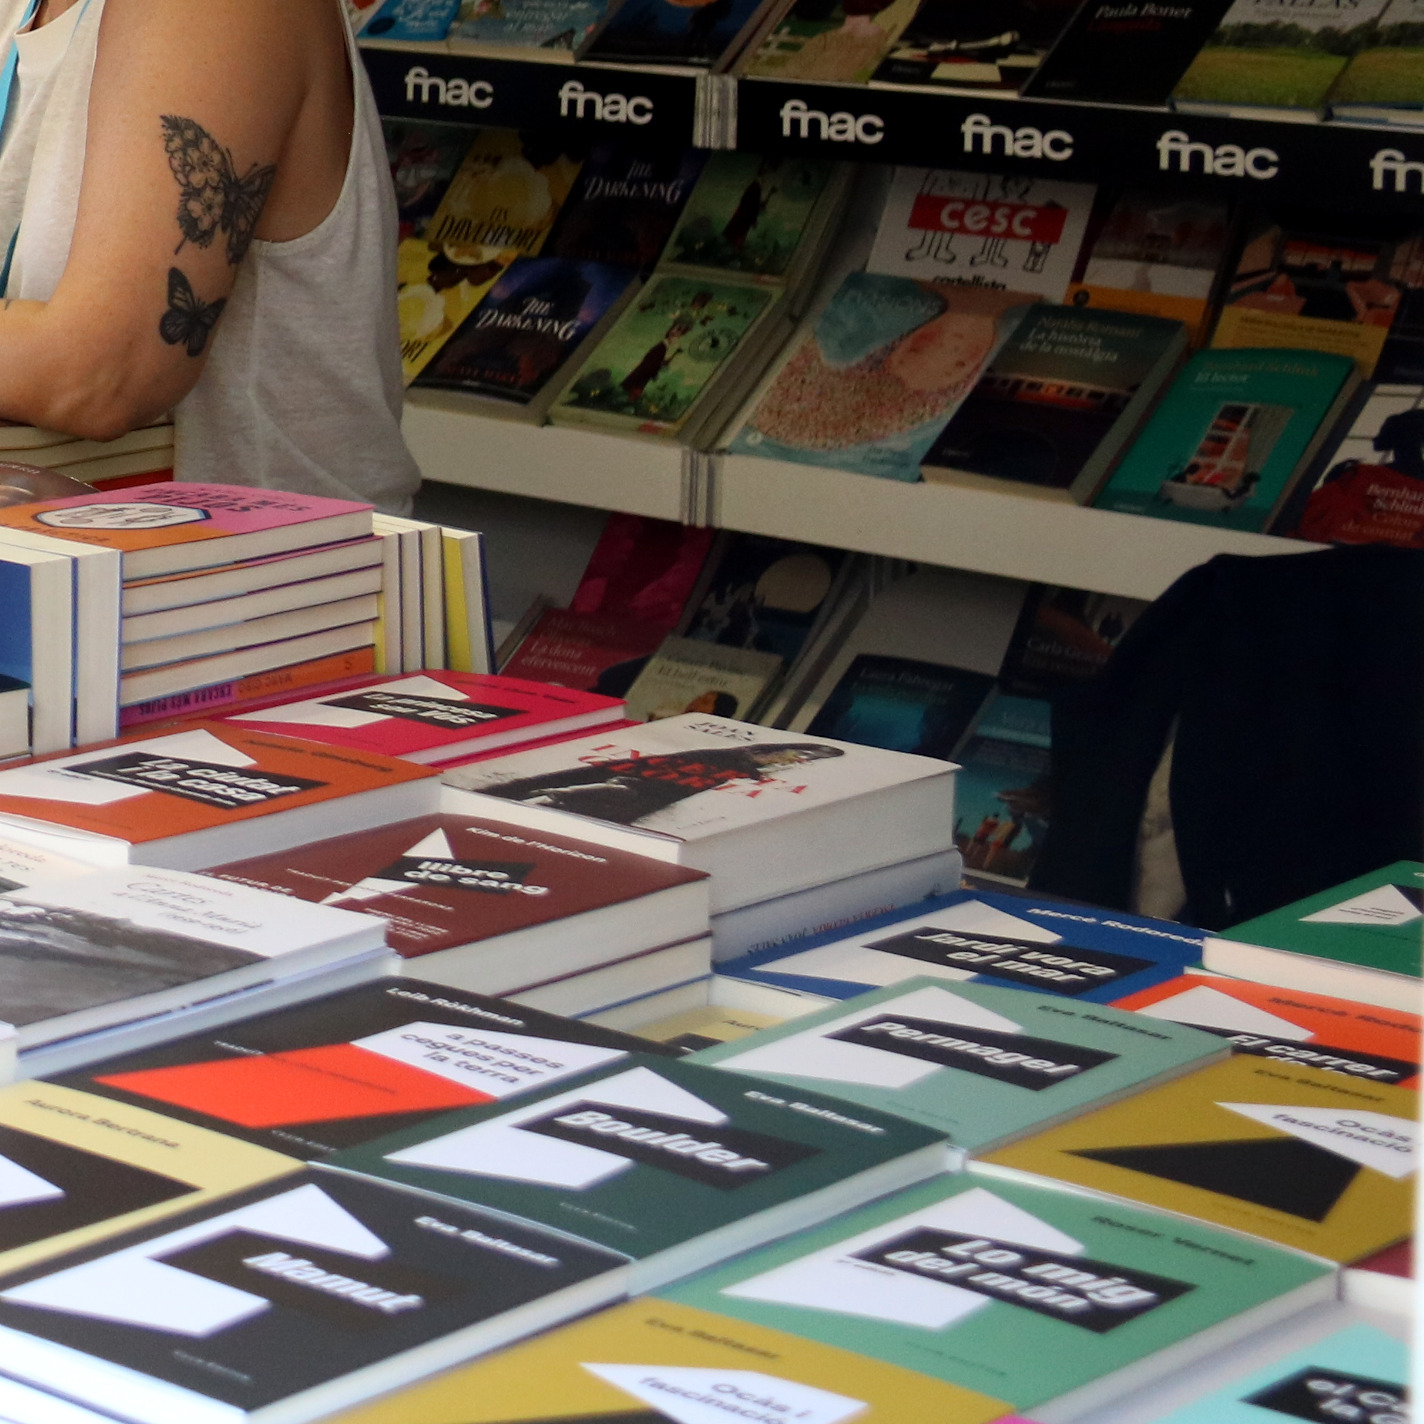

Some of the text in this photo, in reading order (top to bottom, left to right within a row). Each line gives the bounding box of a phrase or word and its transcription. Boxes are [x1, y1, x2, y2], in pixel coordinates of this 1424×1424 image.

[405, 67, 653, 124] fnac fnac
[780, 100, 1278, 179] fnac fnac fnac
[940, 200, 1037, 236] cesc
[457, 876, 550, 896] sang
[946, 950, 1087, 982] el mar
[1019, 949, 1117, 976] vora
[400, 1032, 544, 1076] cegues per
[423, 1050, 520, 1084] la terra
[462, 1037, 565, 1070] passes
[860, 1021, 1081, 1074] Permagel
[1226, 1034, 1400, 1077] El carrer
[24, 1097, 90, 1121] Aurora
[554, 1110, 770, 1172] Boulder
[241, 1251, 426, 1314] Mamut
[883, 1249, 1092, 1314] del món
[941, 1239, 1157, 1308] Lo mig
